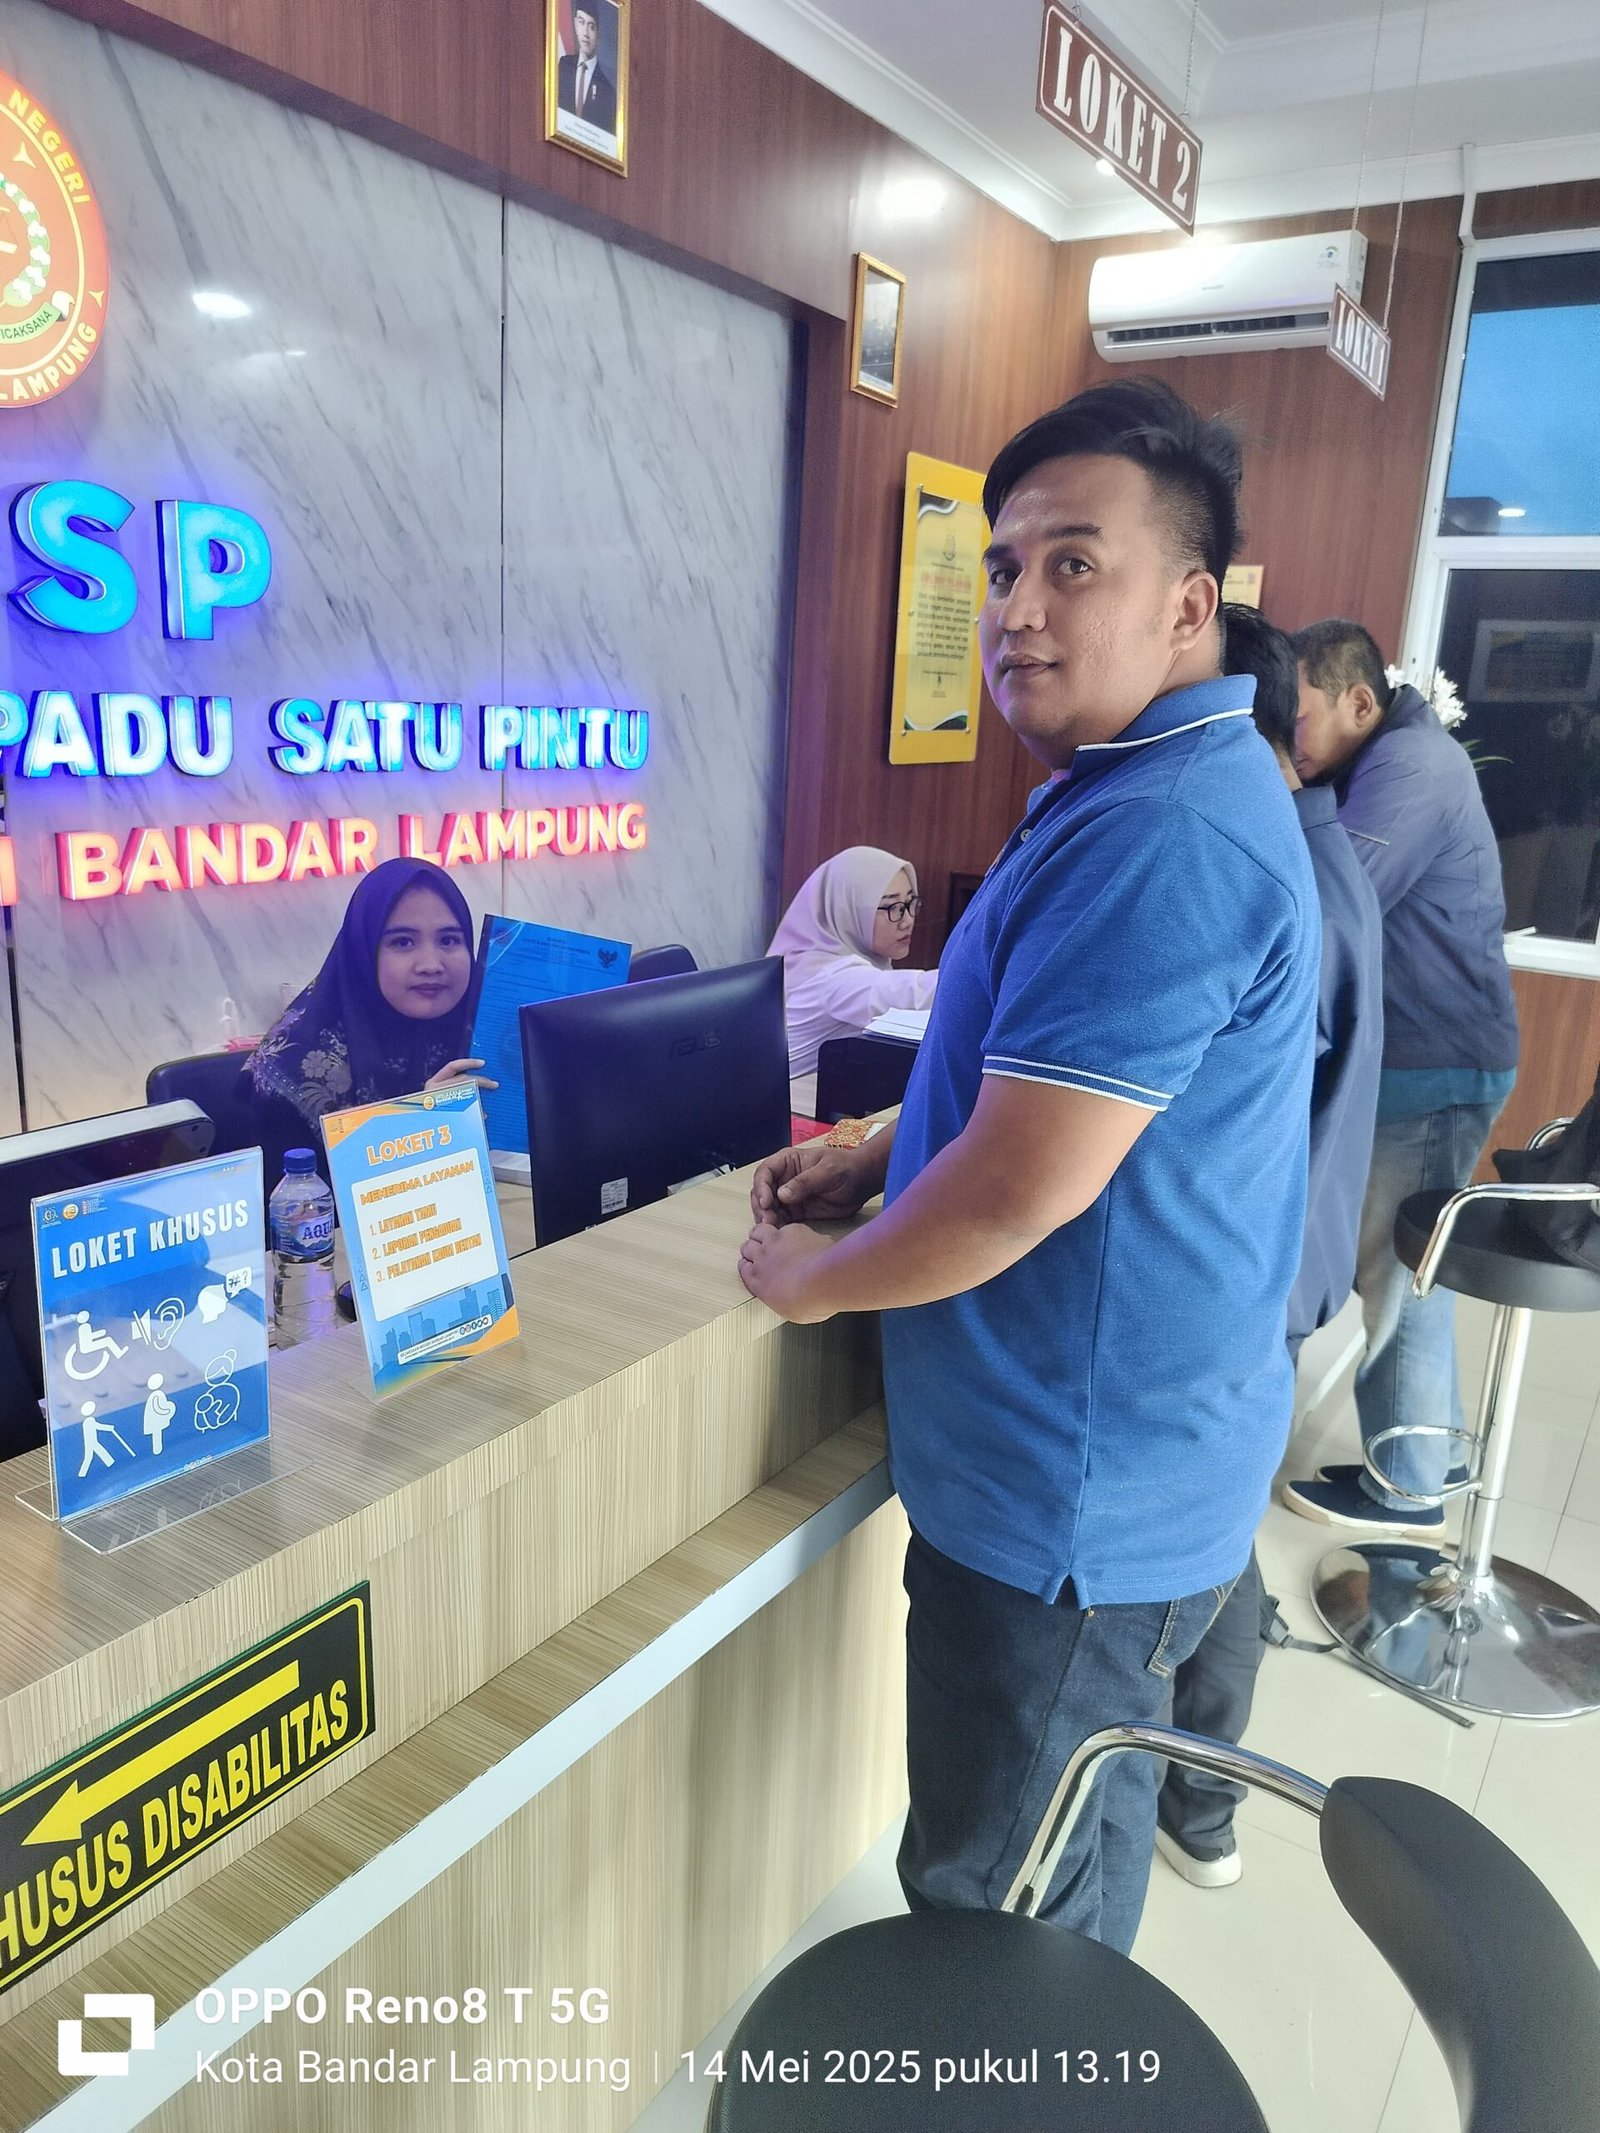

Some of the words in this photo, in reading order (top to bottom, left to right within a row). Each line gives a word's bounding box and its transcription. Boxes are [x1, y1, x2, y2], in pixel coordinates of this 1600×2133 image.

[8, 88, 92, 204] NEGERI
[1053, 26, 1167, 190] LOKET
[1172, 140, 1192, 212] 2
[1335, 299, 1379, 379] LOKET
[9, 479, 272, 640] SP
[268, 697, 463, 775] SATU
[480, 704, 650, 771] PINTU
[56, 816, 379, 900] BANDAR
[399, 802, 648, 868] LAMPUNG
[359, 1177, 423, 1206] MENERIMA
[422, 1160, 475, 1186] LAYANAN
[366, 1128, 435, 1167] LOKET
[437, 1124, 453, 1146] 3
[51, 1226, 138, 1280] LOKET
[148, 1198, 249, 1253] KHUSUS
[142, 1679, 349, 1868] DISABILITAS
